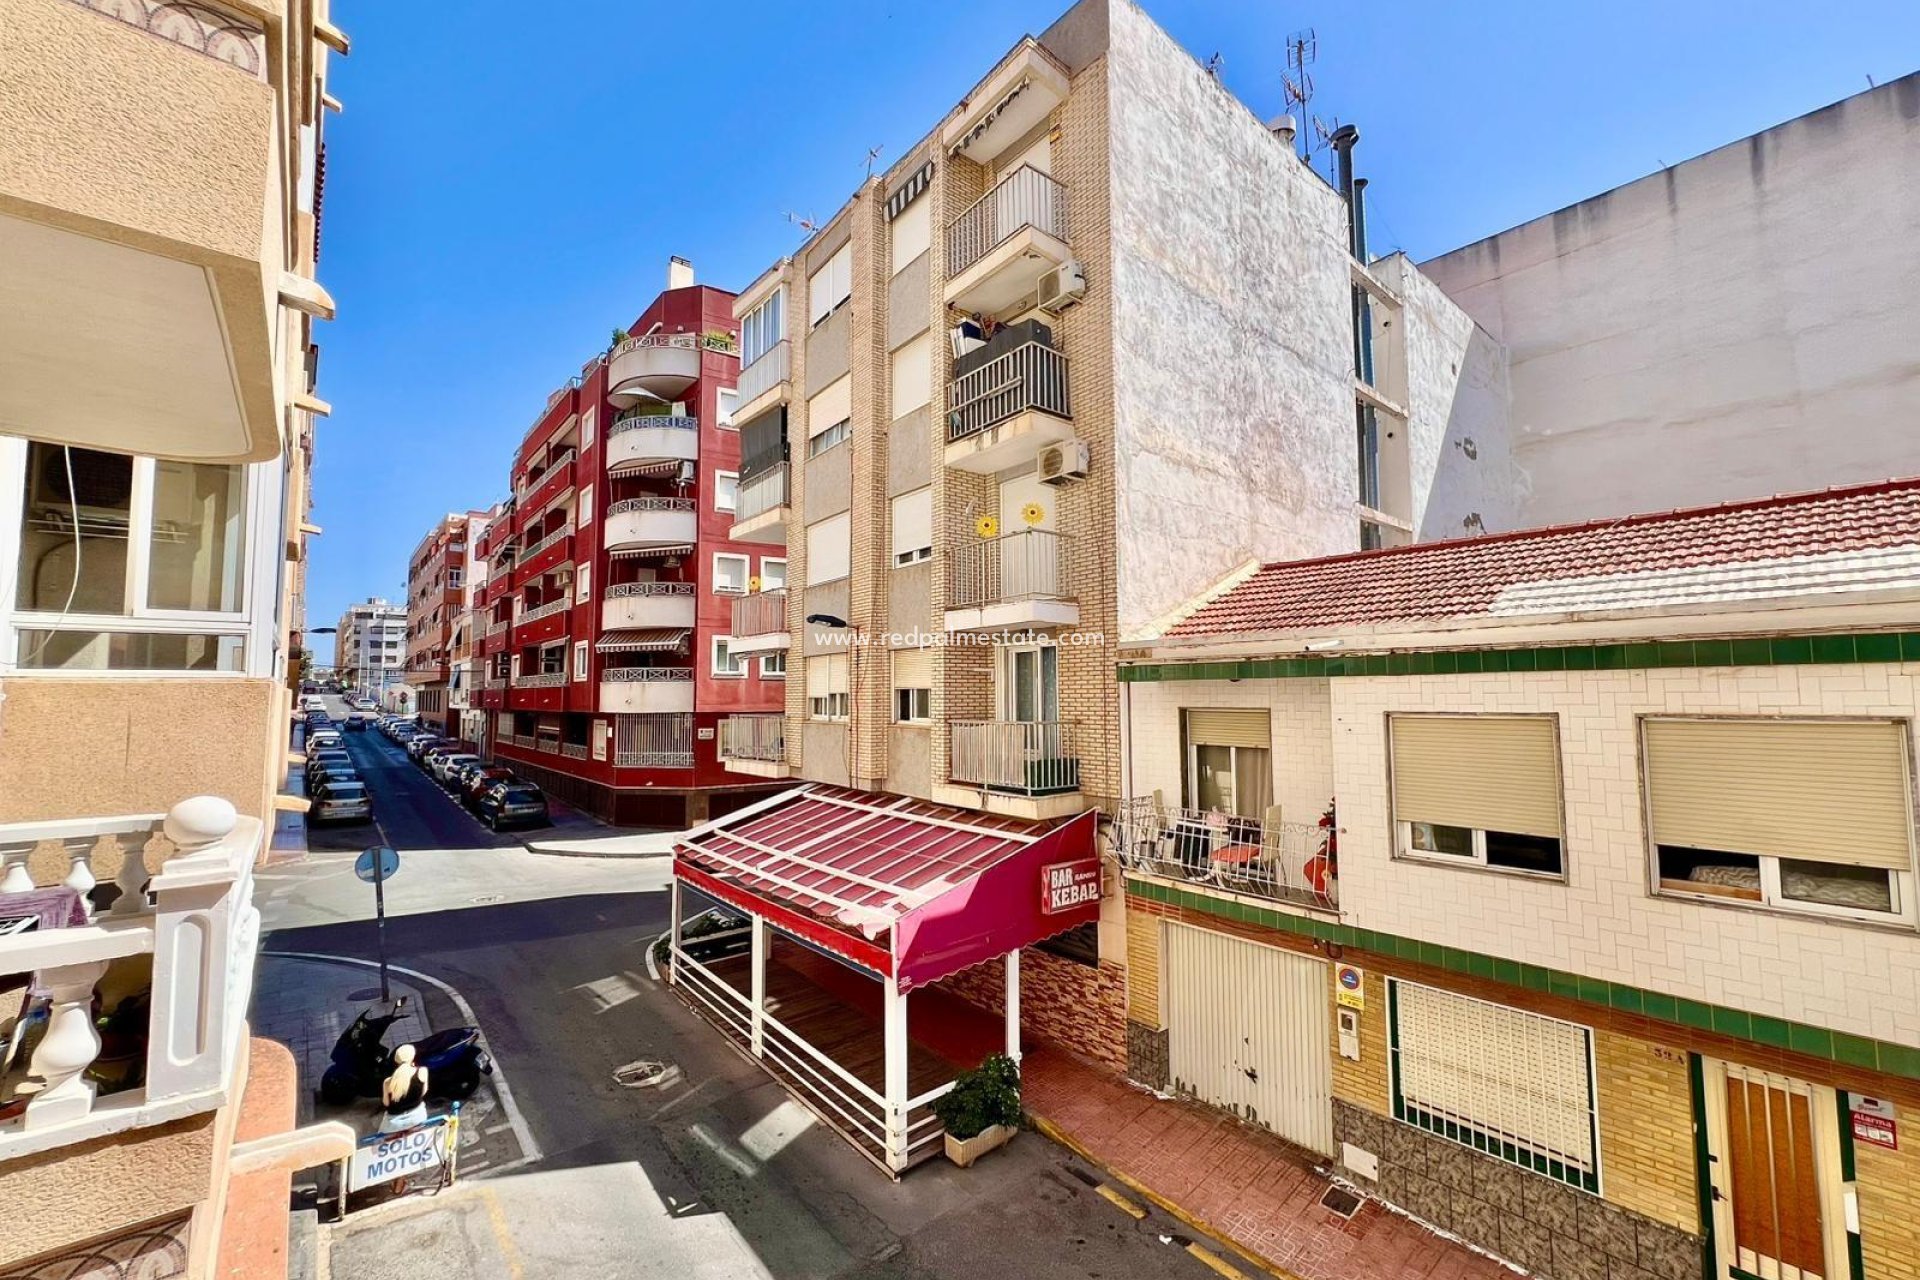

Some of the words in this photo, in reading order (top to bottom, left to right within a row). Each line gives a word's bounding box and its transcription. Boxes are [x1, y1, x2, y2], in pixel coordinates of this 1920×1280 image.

[1051, 868, 1073, 889] BAR
[378, 1132, 426, 1158] SOLO
[367, 1147, 433, 1179] MOTOS
